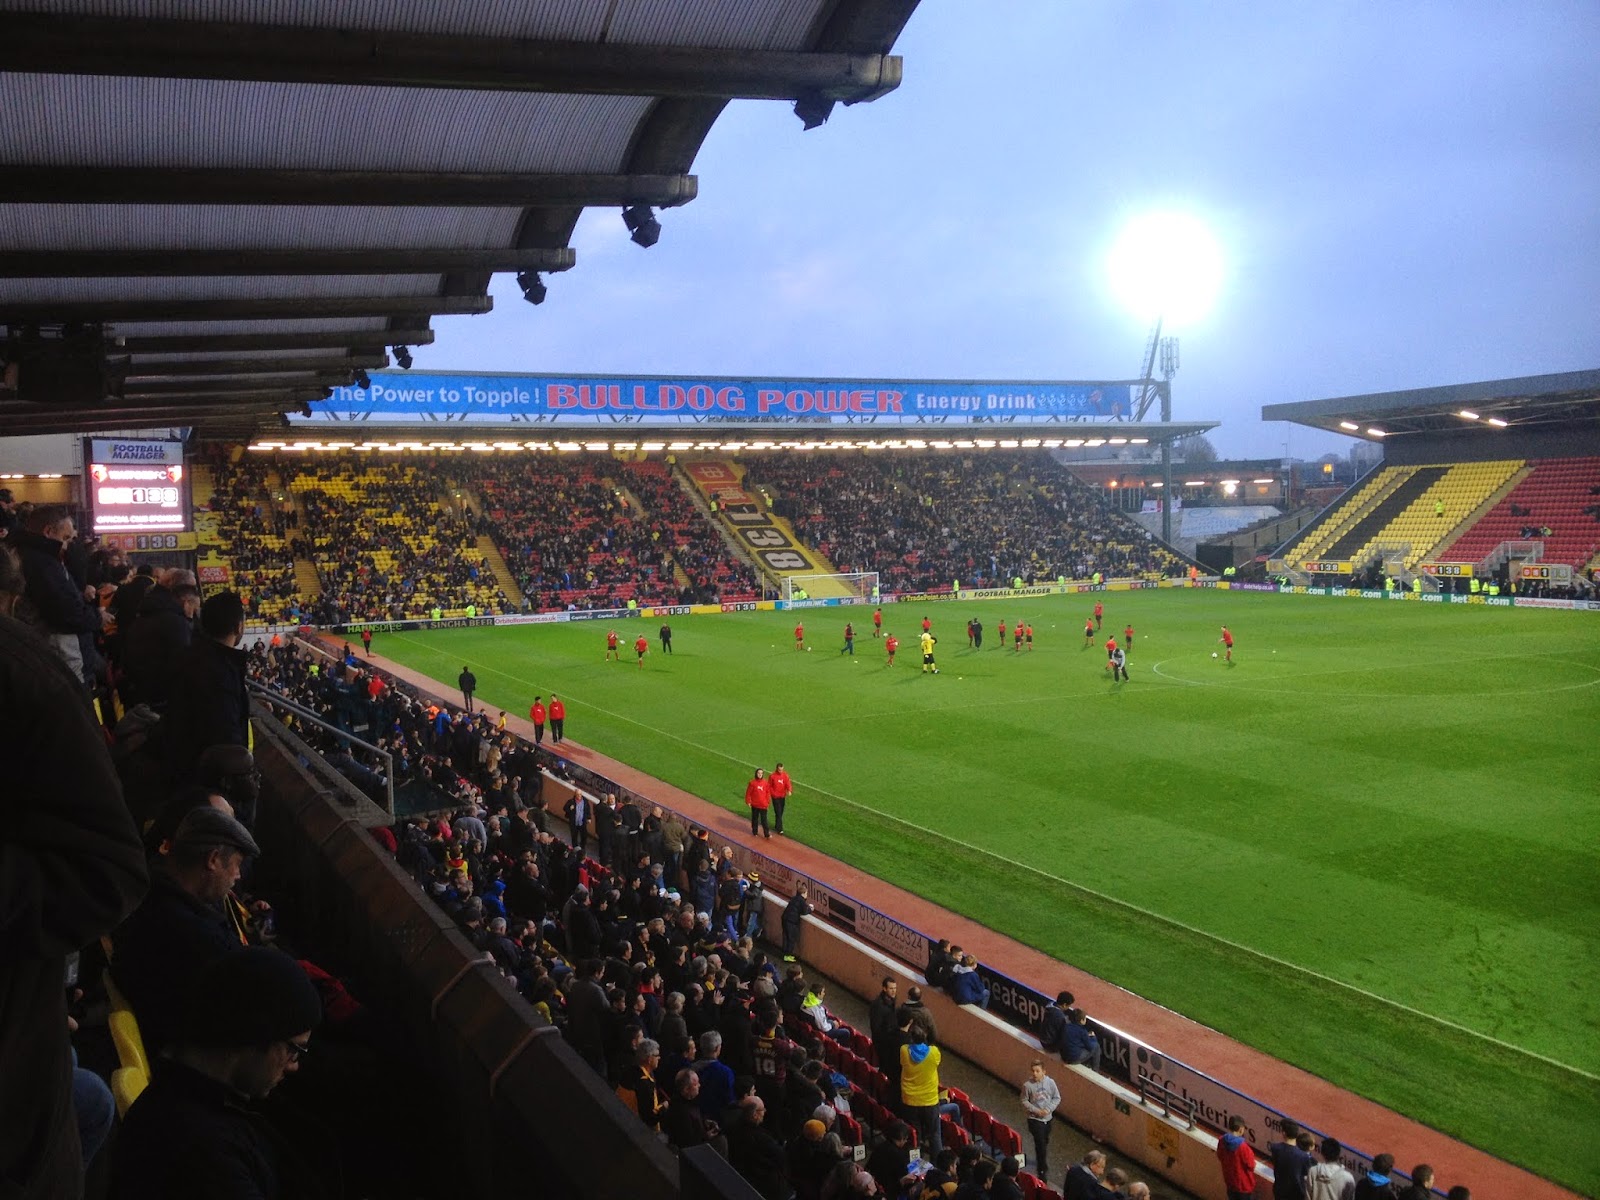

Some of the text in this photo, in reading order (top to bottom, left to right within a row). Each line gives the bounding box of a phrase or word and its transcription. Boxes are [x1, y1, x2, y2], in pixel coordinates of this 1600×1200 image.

[371, 385, 434, 403] Power
[439, 386, 460, 403] to
[464, 386, 530, 407] Topple
[546, 384, 905, 413] BULLDOG POWER
[916, 393, 1036, 411] Energy Drink
[113, 444, 164, 452] FOOTBALL
[111, 452, 165, 460] MANAGER
[137, 535, 178, 549] 138
[1319, 563, 1339, 572] 138
[1437, 565, 1461, 576] 138
[974, 588, 1051, 598] FOOTBALL MANAGER
[1280, 585, 1326, 596] bet365.com
[1331, 587, 1382, 599] bet365.com
[1388, 590, 1443, 602] bet365.com
[1450, 593, 1510, 606] bet365.com
[668, 606, 691, 616] 138
[735, 603, 757, 612] 138
[430, 619, 493, 629] SINGHA BEER
[796, 877, 828, 907] collins
[859, 904, 886, 932] 01923
[1181, 1087, 1256, 1144] Interis
